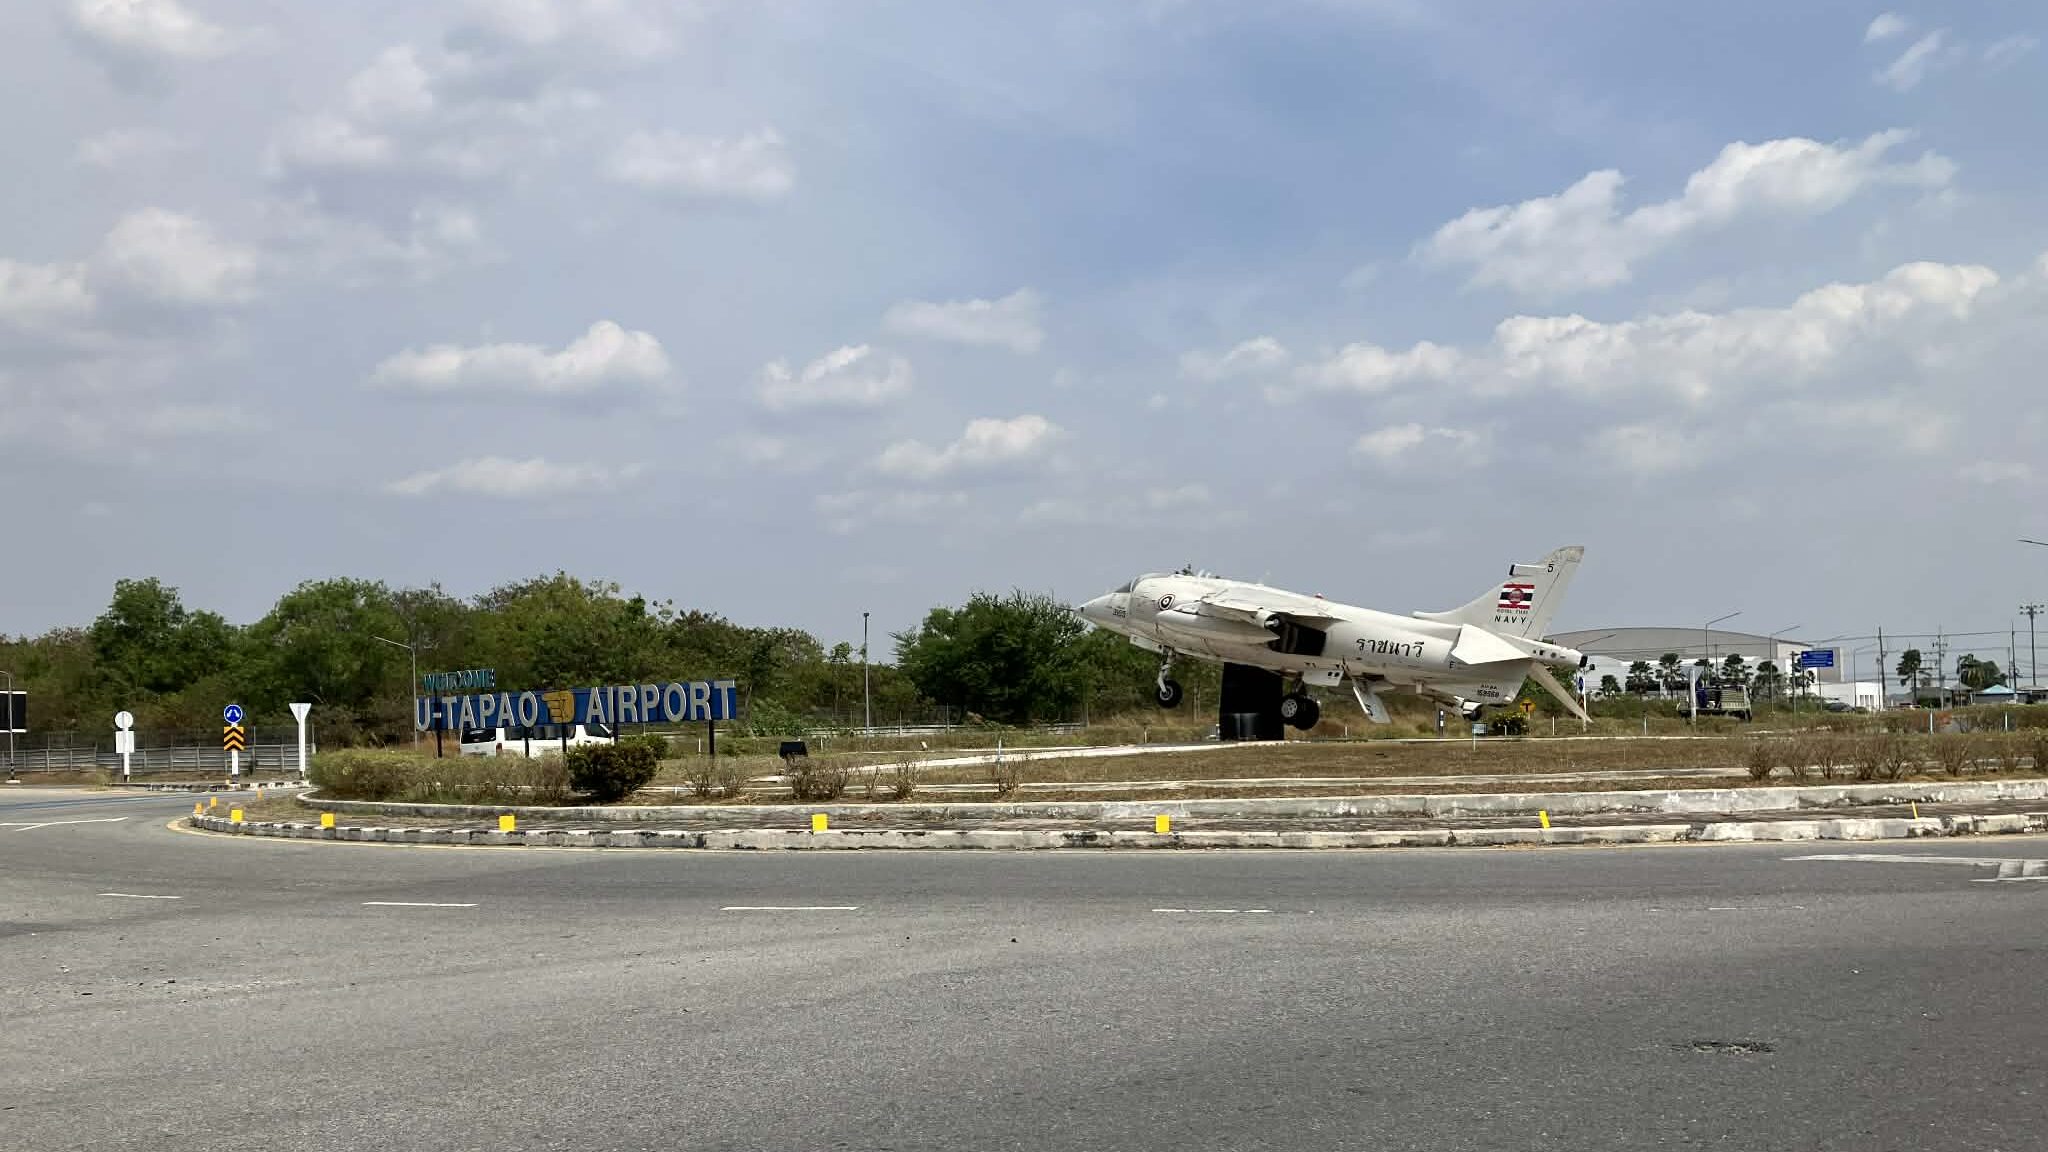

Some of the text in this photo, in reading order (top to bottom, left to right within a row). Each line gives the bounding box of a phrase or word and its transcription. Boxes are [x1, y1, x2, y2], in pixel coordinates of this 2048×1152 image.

[1547, 563, 1555, 573] 5
[1494, 614, 1527, 624] NAVY
[1356, 638, 1425, 658] ราชนาวี
[415, 679, 736, 732] U-TAPAO AIRPORT
